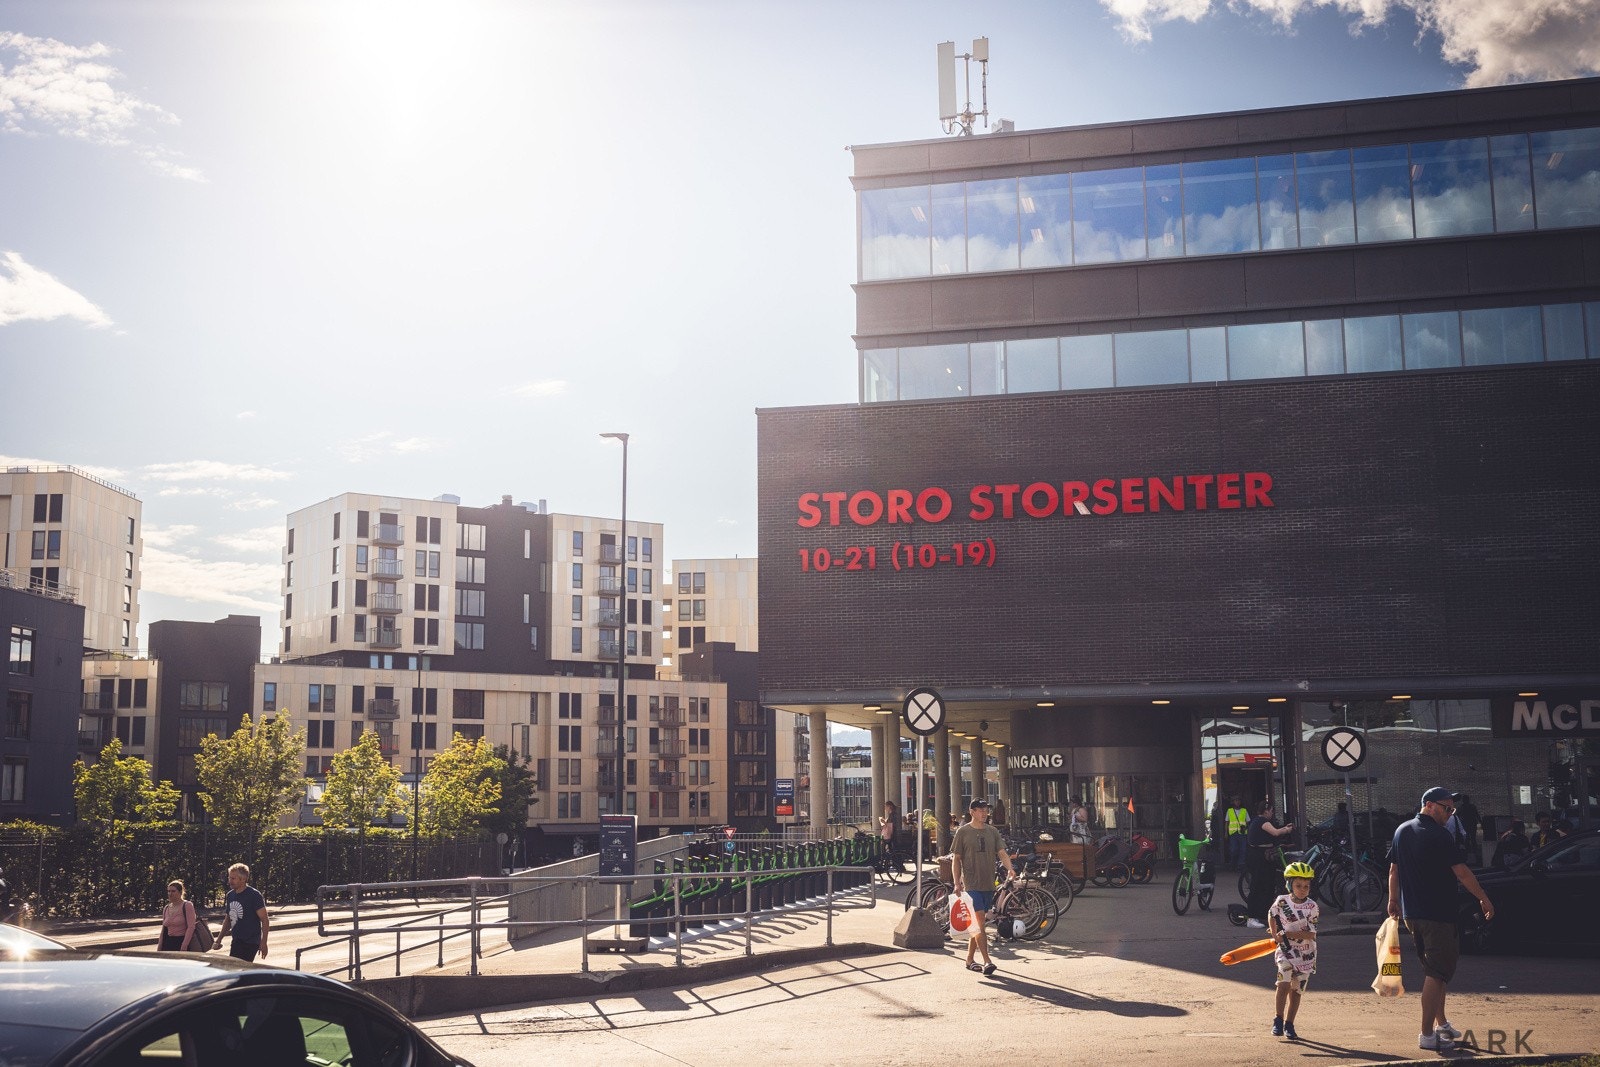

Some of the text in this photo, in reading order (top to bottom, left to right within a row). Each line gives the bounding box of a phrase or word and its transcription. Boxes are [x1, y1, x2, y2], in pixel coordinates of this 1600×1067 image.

[797, 472, 1273, 529] STORO STORSENTER
[799, 537, 997, 573] 10-21 (10-19)
